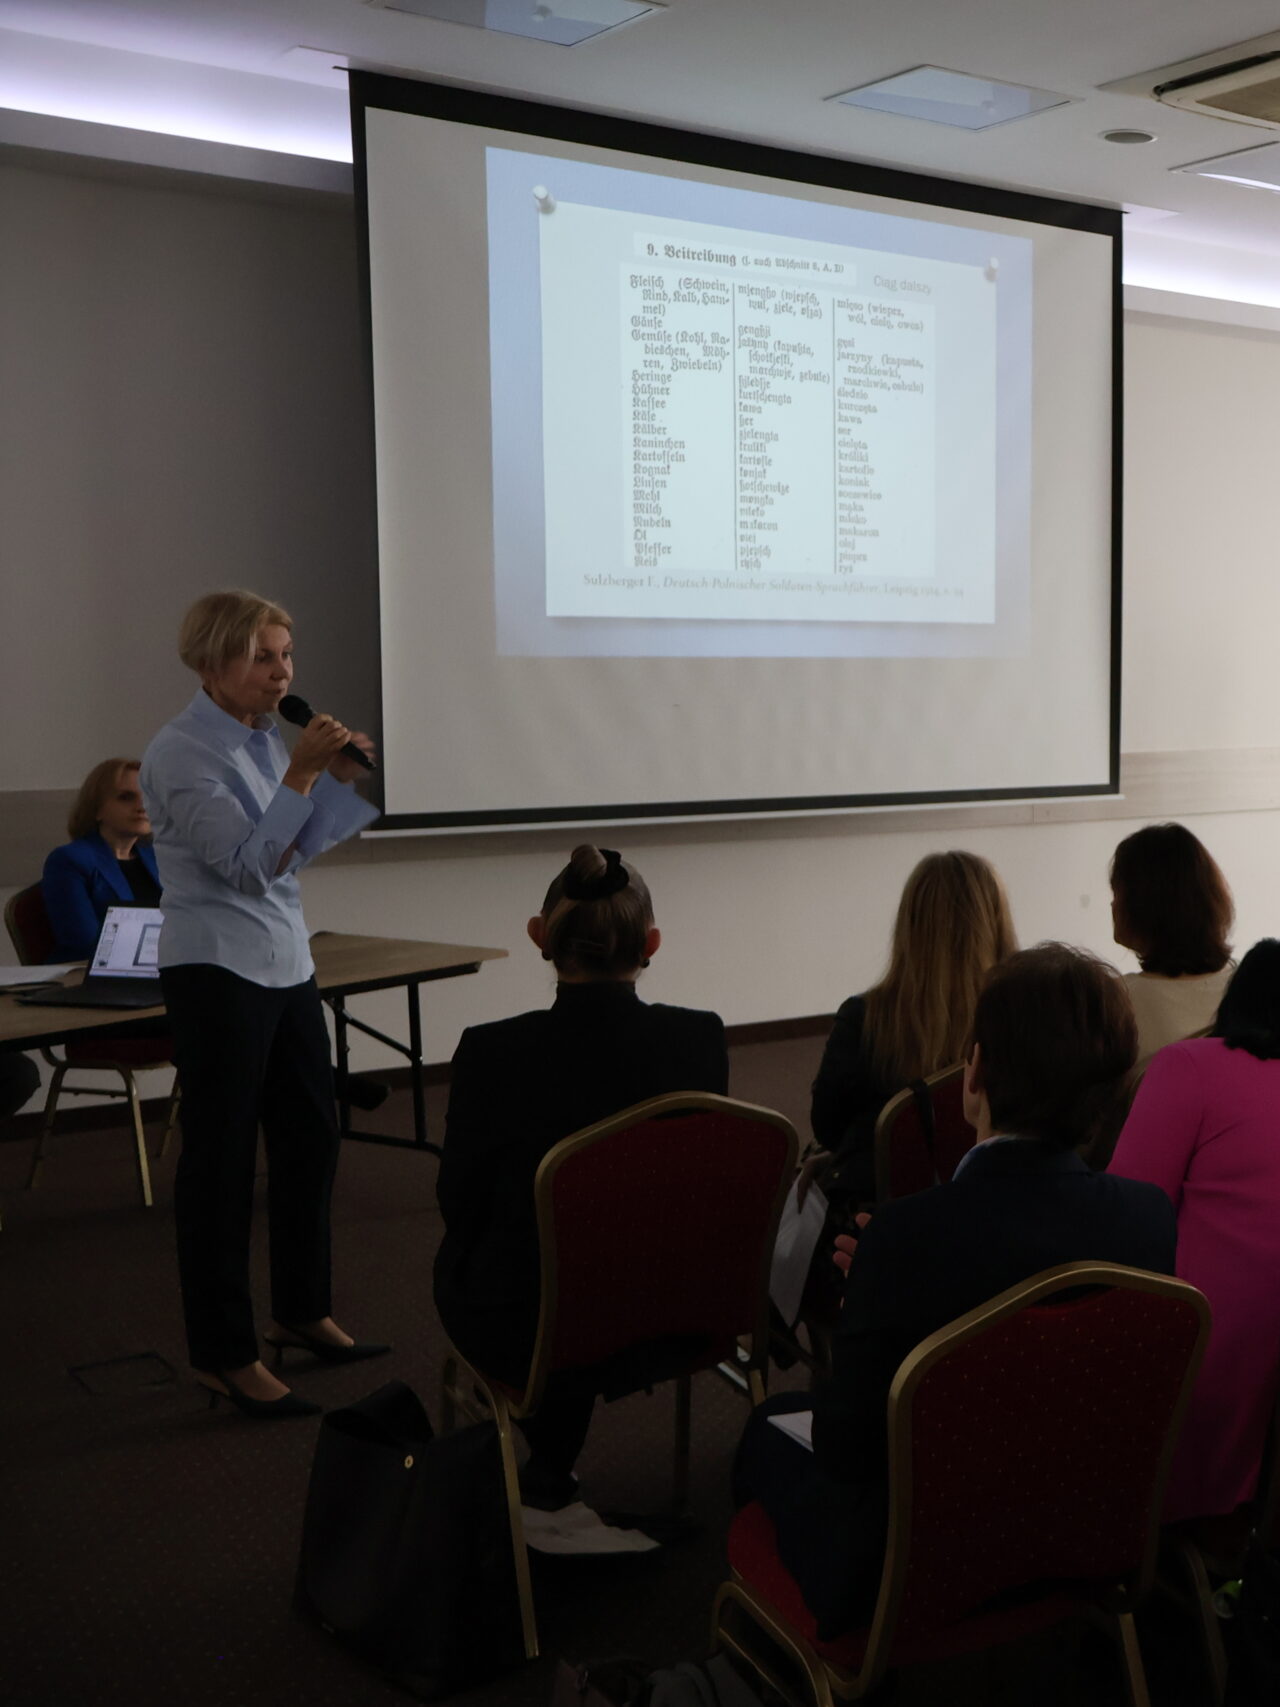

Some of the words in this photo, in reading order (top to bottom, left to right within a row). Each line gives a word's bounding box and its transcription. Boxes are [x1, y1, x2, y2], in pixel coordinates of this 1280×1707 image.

[647, 243, 658, 257] 9.
[664, 244, 737, 267] Beitreibung
[632, 370, 672, 384] Heringe
[633, 436, 686, 450] Kaninchen
[633, 450, 686, 464] Kartoffeln
[583, 573, 644, 590] Sulzberger
